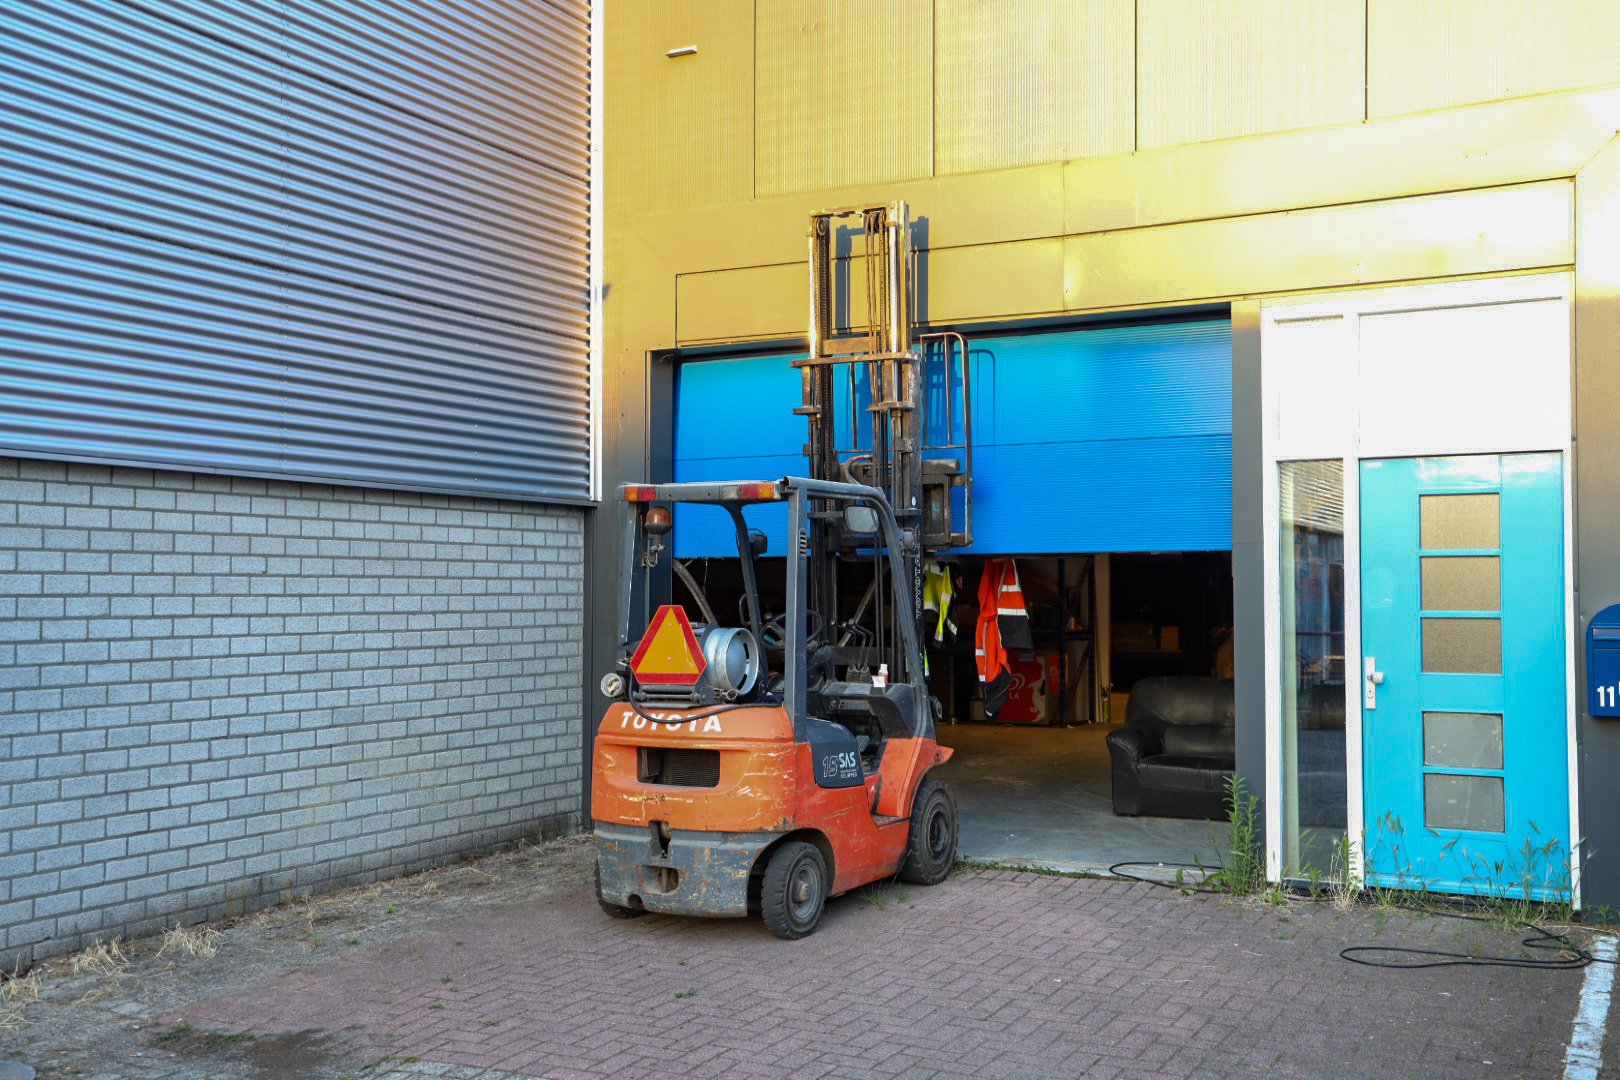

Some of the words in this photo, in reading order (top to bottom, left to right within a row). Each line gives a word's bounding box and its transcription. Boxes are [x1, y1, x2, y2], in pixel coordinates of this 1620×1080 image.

[1597, 686, 1615, 707] 11
[620, 711, 722, 732] TOYOTA
[822, 755, 838, 778] 15
[838, 751, 856, 769] SAS
